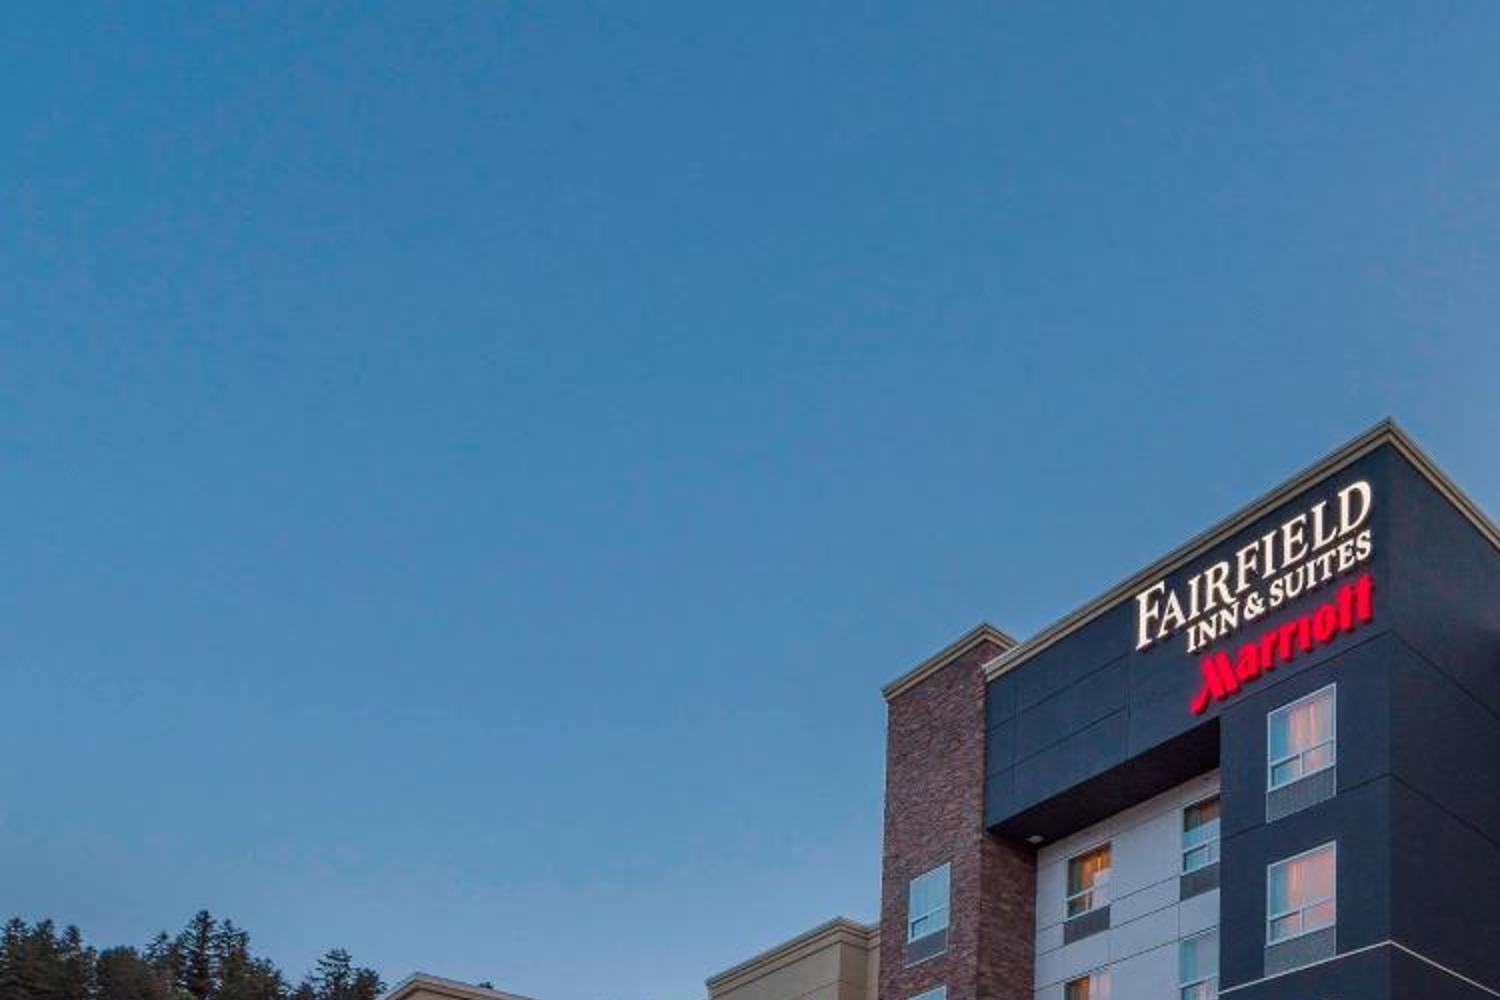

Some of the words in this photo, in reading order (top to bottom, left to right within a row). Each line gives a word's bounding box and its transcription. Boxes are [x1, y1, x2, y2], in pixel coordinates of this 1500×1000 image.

[1135, 480, 1372, 651] FAIRFIELD
[1186, 601, 1240, 653] INN
[1243, 591, 1265, 621] &
[1269, 529, 1372, 608] SUITES
[1189, 572, 1374, 714] Marriott
